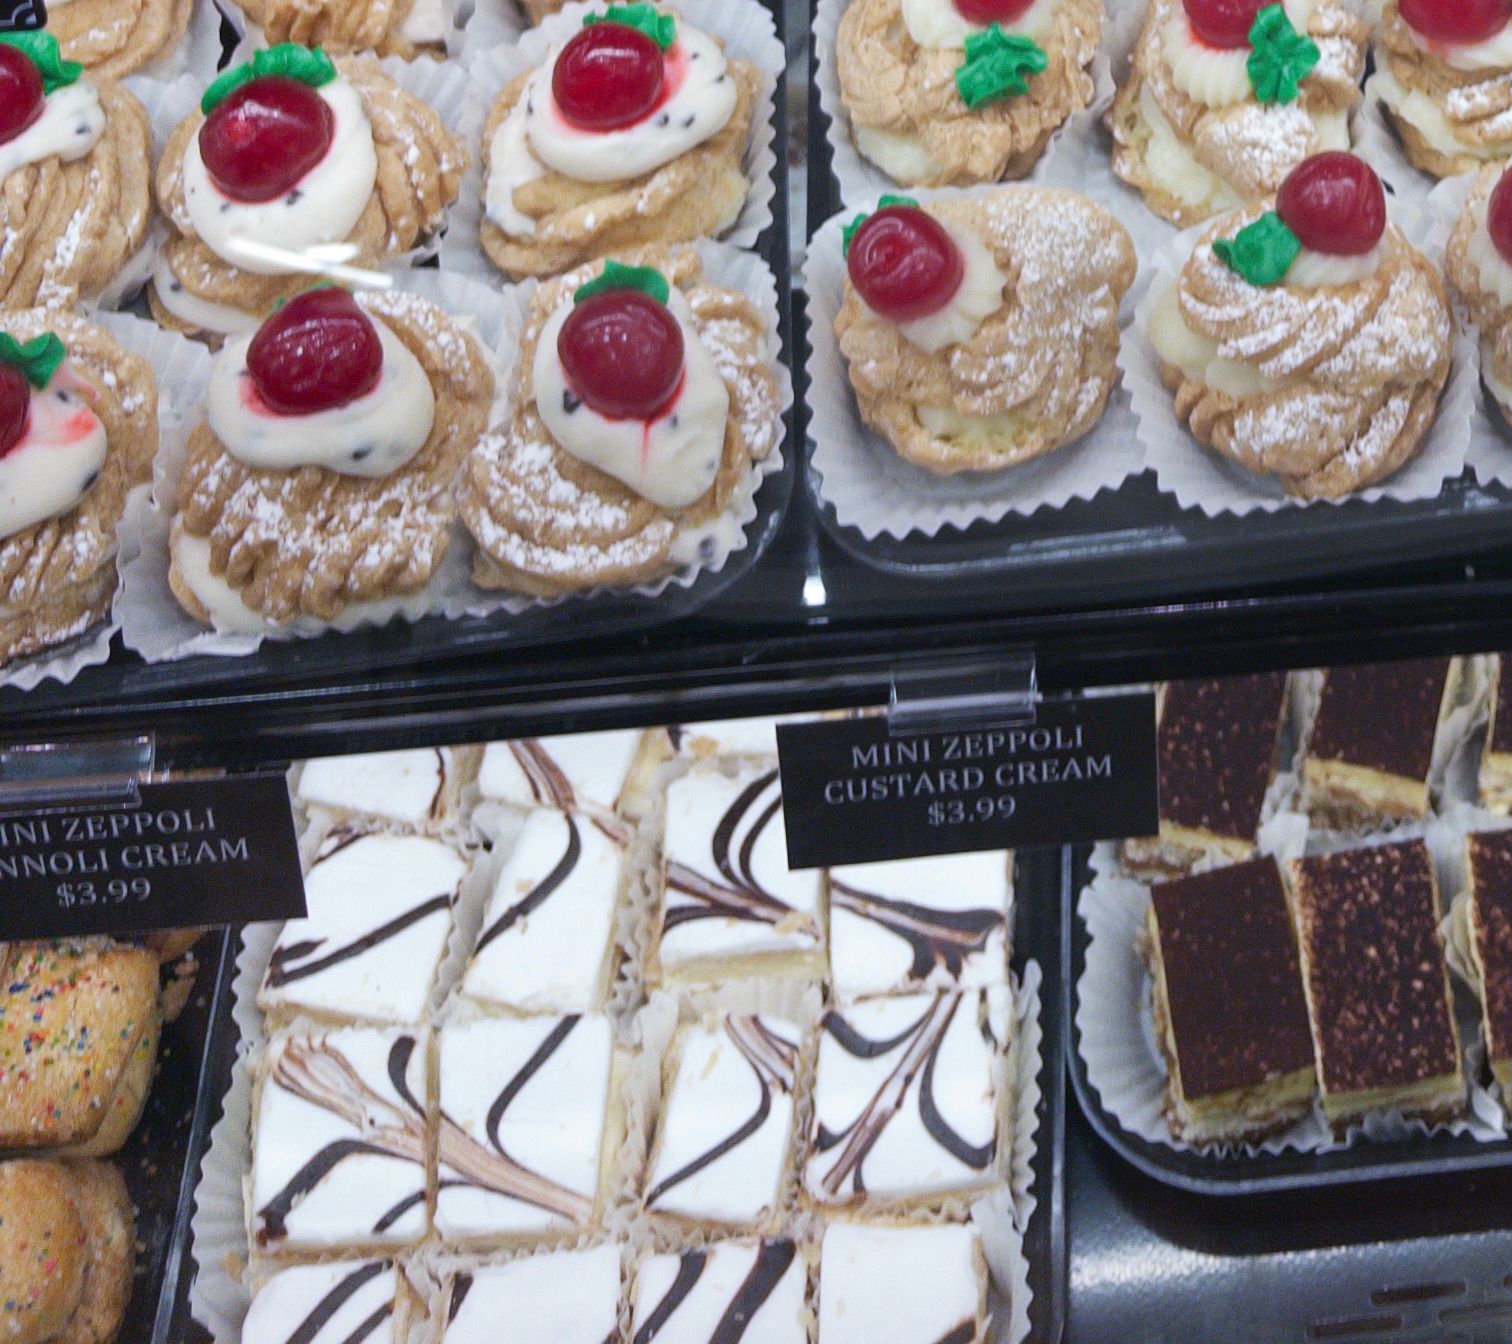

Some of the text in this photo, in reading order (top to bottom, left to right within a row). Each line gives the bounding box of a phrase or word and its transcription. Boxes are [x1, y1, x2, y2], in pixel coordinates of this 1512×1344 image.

[852, 724, 1083, 769] MINI ZEPPOLI
[824, 754, 1112, 805] CUSTARD CREAM
[61, 807, 215, 842] ZEPPOLI
[927, 795, 1016, 826] $3.99
[121, 837, 249, 869] CREAM
[56, 877, 151, 908] $3.99
